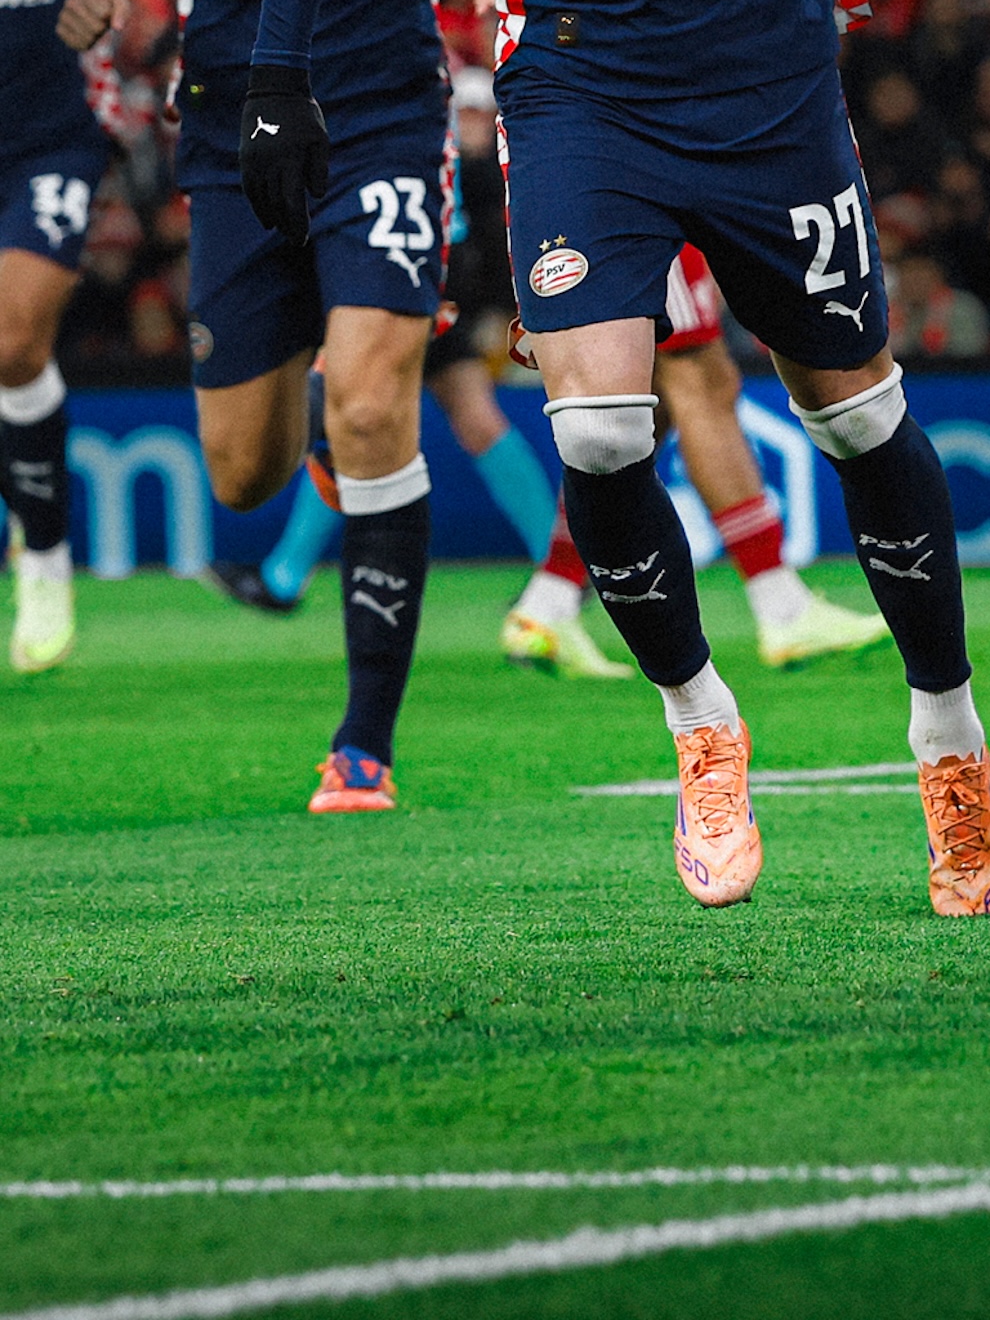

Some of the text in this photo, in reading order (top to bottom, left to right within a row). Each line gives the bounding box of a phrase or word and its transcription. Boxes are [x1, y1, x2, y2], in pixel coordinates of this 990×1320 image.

[359, 177, 435, 250] 23
[788, 182, 871, 295] 27
[546, 263, 566, 277] PSV
[859, 531, 930, 550] PSV
[589, 549, 660, 581] PSV
